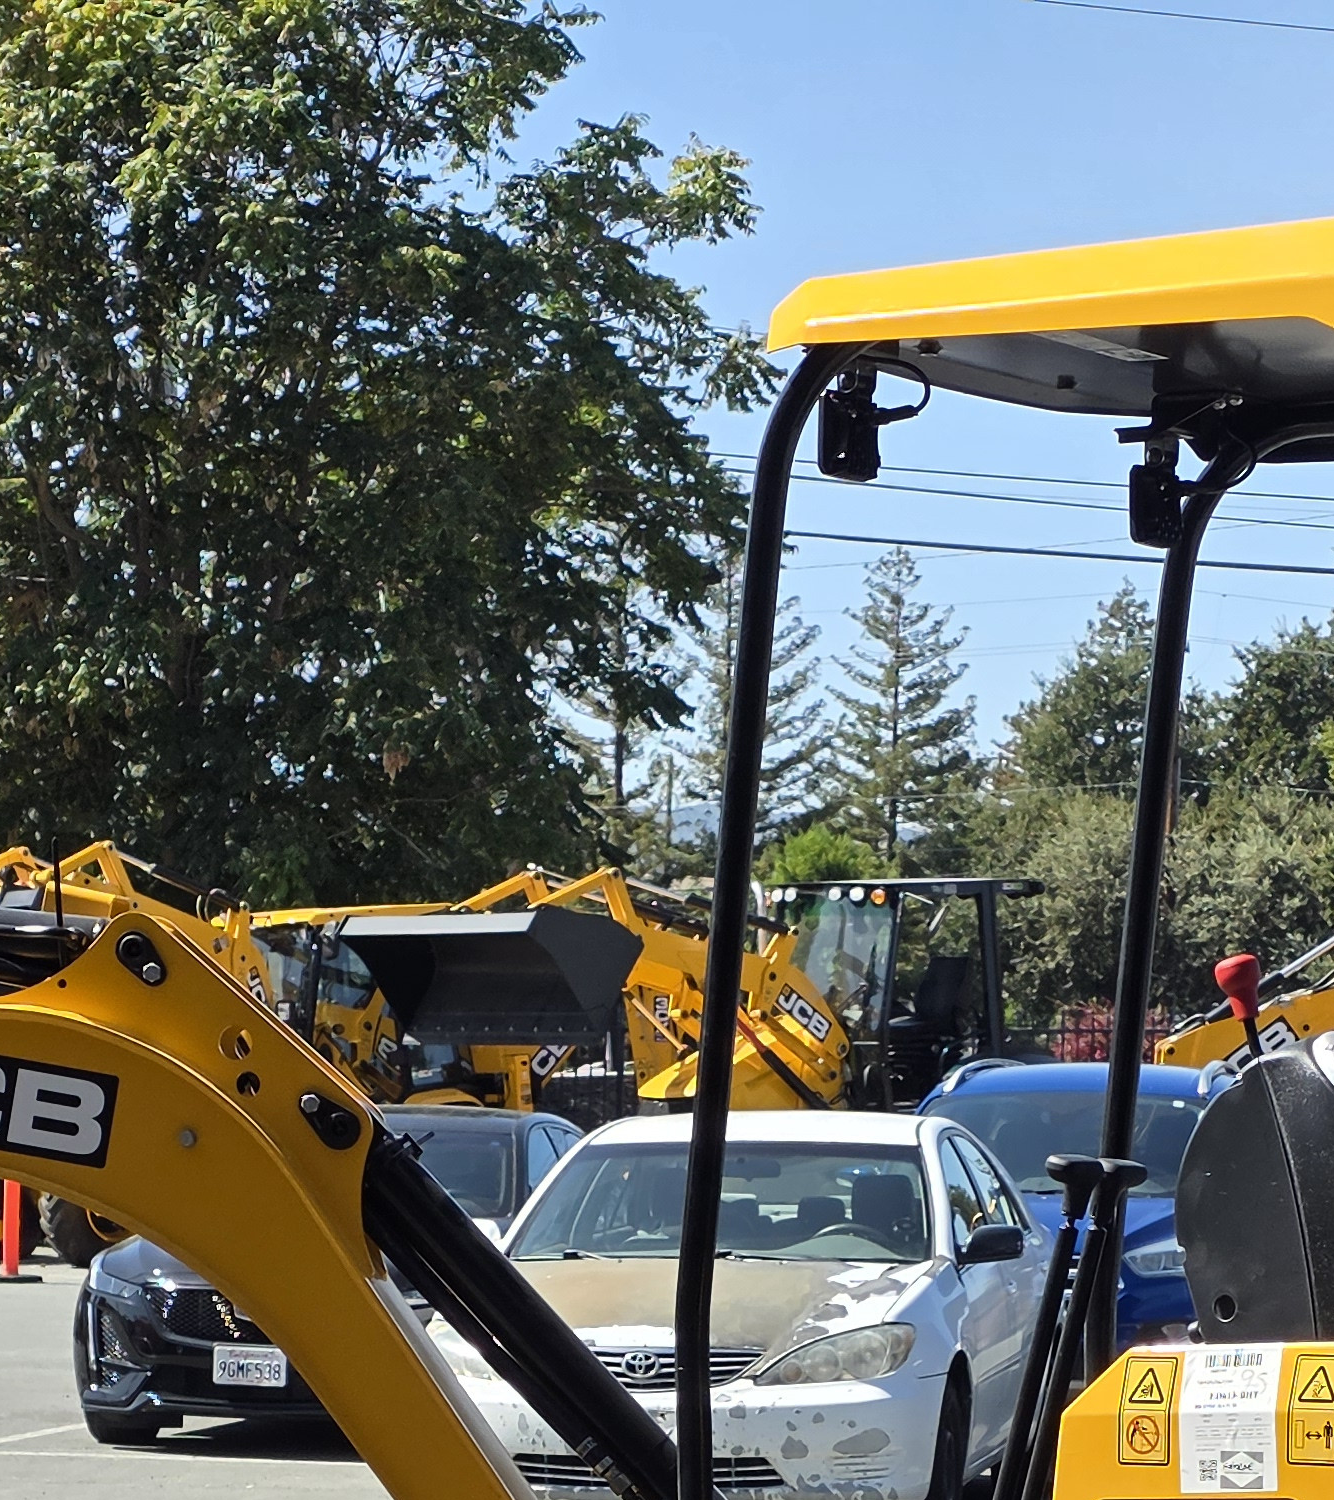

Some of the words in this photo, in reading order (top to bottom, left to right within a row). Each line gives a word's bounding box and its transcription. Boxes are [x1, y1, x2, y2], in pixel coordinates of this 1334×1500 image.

[248, 970, 266, 1003] JC
[777, 992, 830, 1040] JCB
[218, 1361, 281, 1381] 9GMF538
